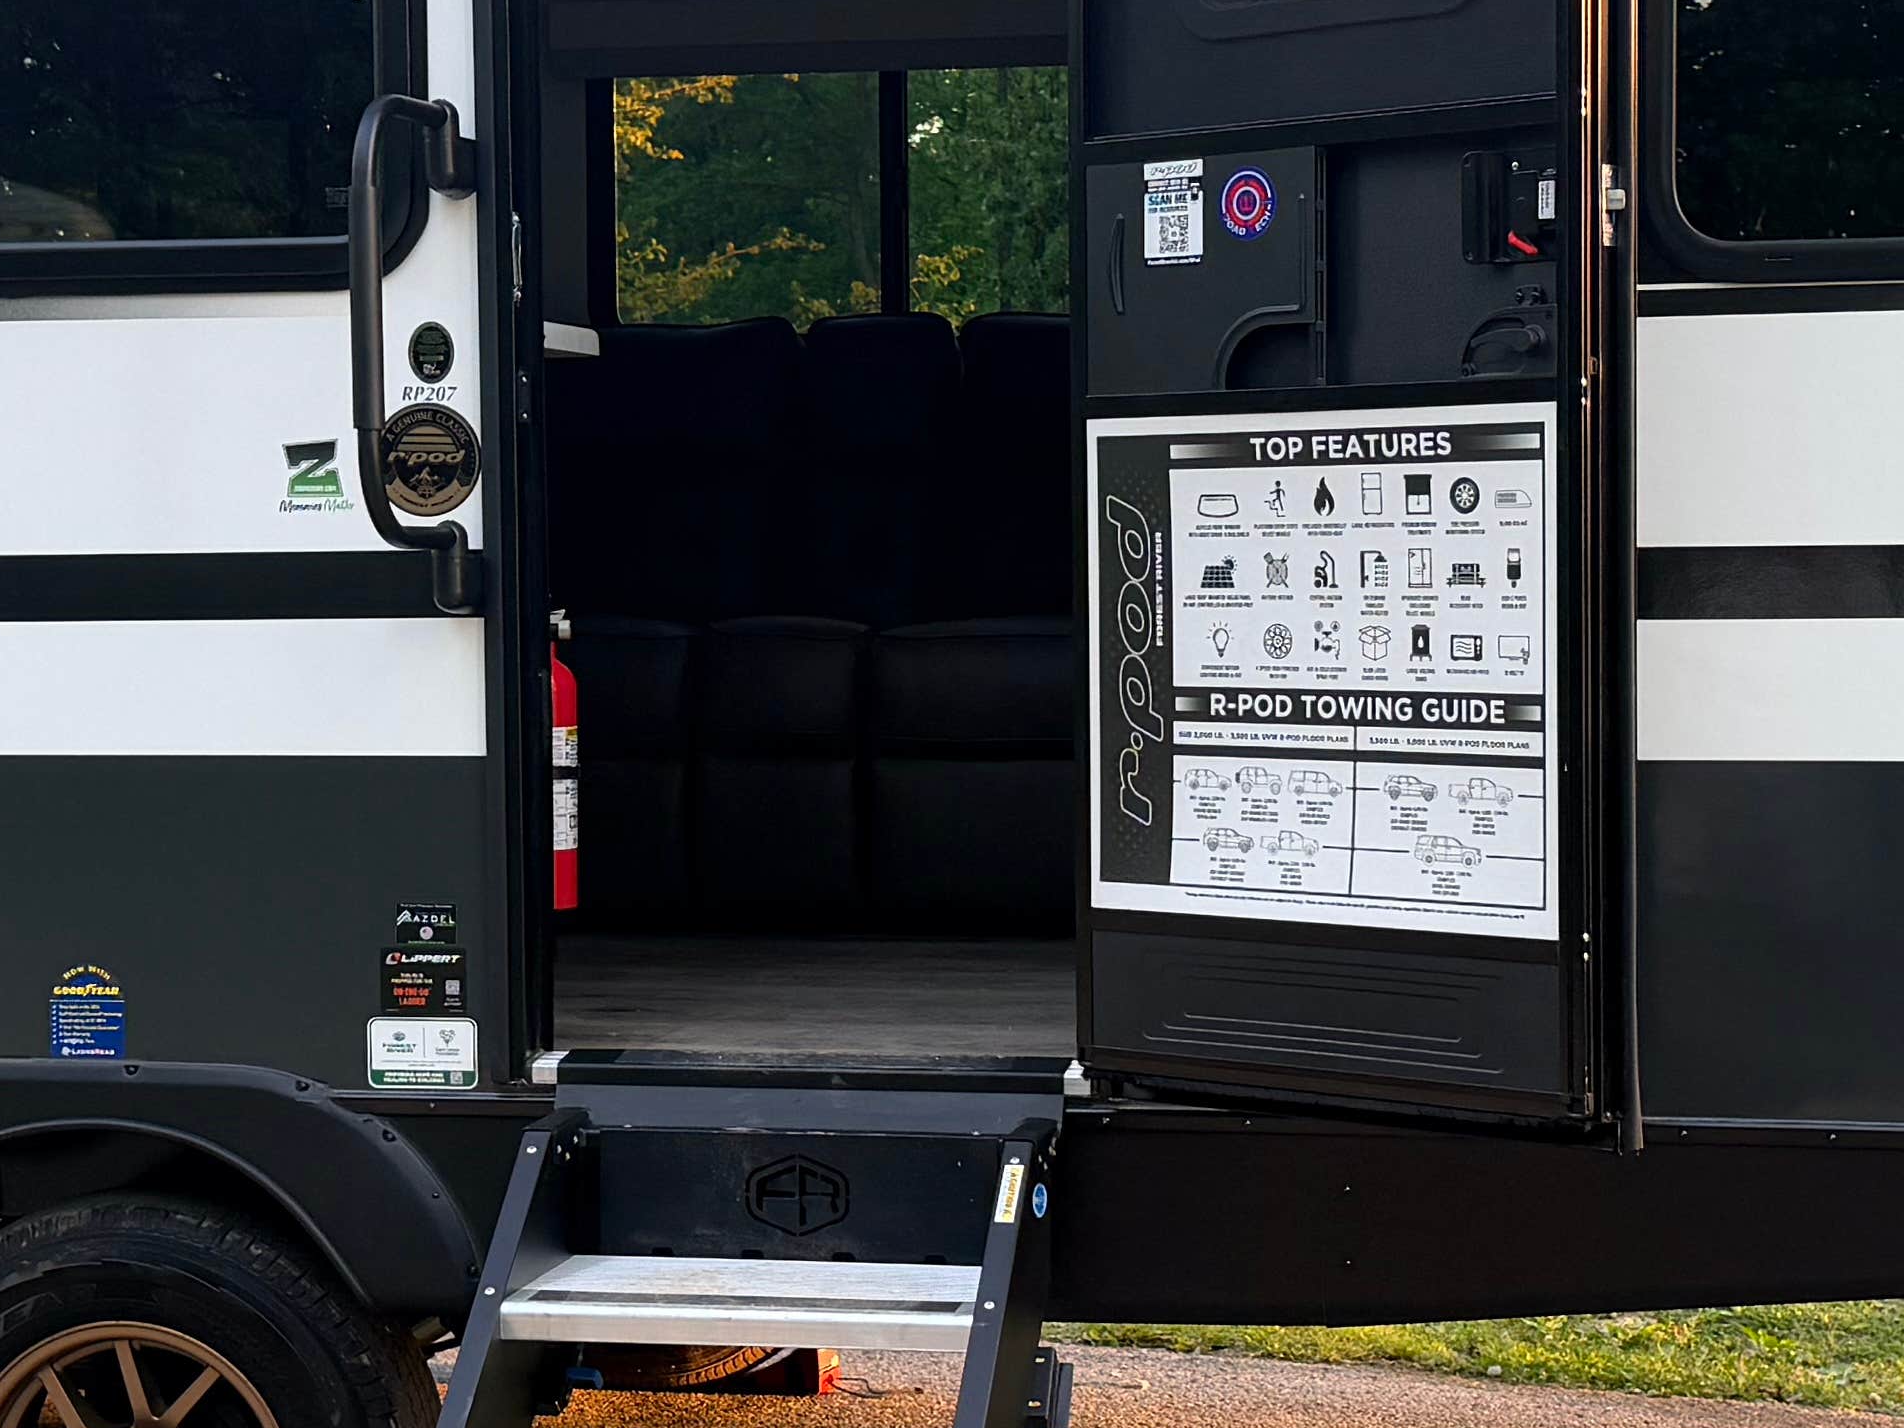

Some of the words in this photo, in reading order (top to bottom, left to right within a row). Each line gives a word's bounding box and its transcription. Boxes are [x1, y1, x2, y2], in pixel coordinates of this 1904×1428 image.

[402, 385, 458, 402] RP207
[393, 411, 434, 436] GENUINE
[1250, 436, 1303, 461] TOP
[1312, 431, 1452, 459] FEATURES
[1154, 531, 1165, 580] RIVER
[1154, 582, 1165, 647] FOREST
[1210, 692, 1293, 718] R-POD
[1301, 694, 1414, 722] TOWING
[1422, 697, 1505, 725] GUIDE
[413, 913, 456, 924] AZDEL
[401, 953, 463, 964] LIPPERT
[52, 983, 120, 997] GOODYEAR
